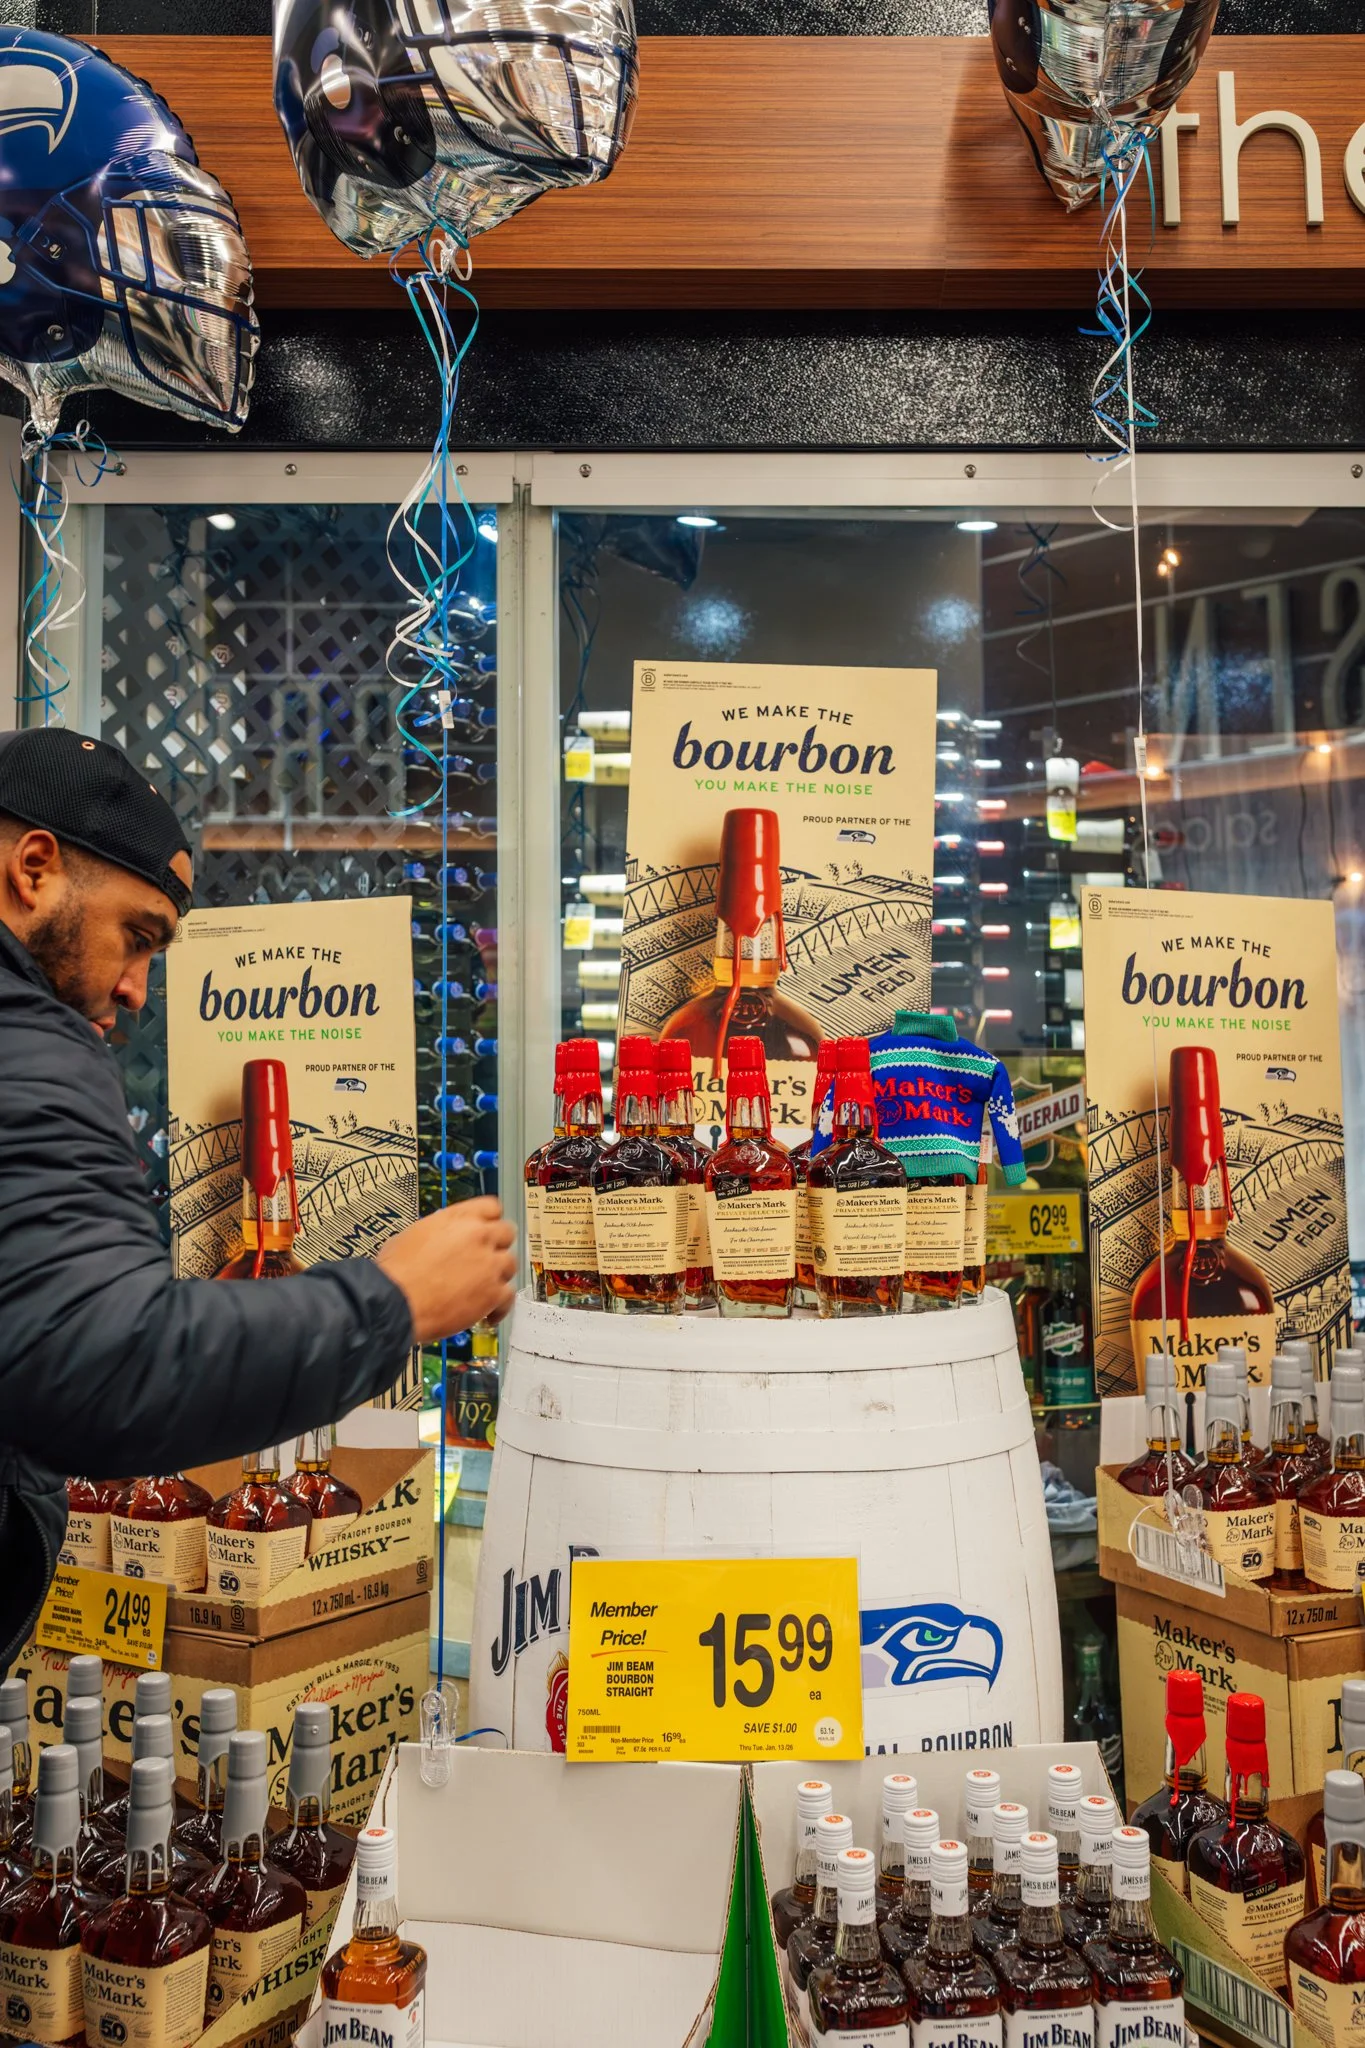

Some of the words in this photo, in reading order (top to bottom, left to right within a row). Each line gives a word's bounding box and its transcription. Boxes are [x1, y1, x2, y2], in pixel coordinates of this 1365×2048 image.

[722, 707, 748, 721] WE
[756, 705, 809, 718] MAKE
[817, 707, 853, 725] THE
[673, 721, 896, 775] bourbon
[694, 779, 726, 791] YOU
[733, 781, 779, 792] MAKE
[785, 782, 816, 794] THE
[823, 783, 873, 795] NOISE
[802, 815, 833, 824] PROUD
[835, 816, 877, 825] PARTNER
[879, 817, 891, 825] OF
[893, 818, 911, 826] THE
[235, 952, 257, 968] WE
[263, 946, 305, 962] MAKE
[311, 948, 342, 964] THE
[1161, 938, 1184, 952] WE
[1190, 936, 1235, 949] MAKE
[1241, 939, 1272, 958] THE
[807, 948, 912, 1004] LUMEN
[1122, 952, 1308, 1010] bourbon
[200, 965, 380, 1021] bourbon
[860, 970, 916, 1003] FIELD
[1142, 1015, 1170, 1028] YOU
[1176, 1017, 1214, 1029] MAKE
[1220, 1018, 1246, 1030] THE
[1251, 1019, 1292, 1031] NOISE
[217, 1031, 243, 1042] YOU
[248, 1030, 284, 1041] MAKE
[290, 1029, 316, 1040] THE
[321, 1028, 362, 1040] NOISE
[305, 1064, 331, 1072] PROUD
[332, 1063, 366, 1072] PARTNER
[368, 1063, 378, 1071] OF
[380, 1063, 395, 1071] THE
[1236, 1053, 1261, 1061] PROUD
[1263, 1054, 1296, 1062] PARTNER
[692, 1071, 807, 1097] Mar's
[873, 1077, 973, 1104] Maker's
[903, 1099, 972, 1127] Mark
[1252, 1189, 1332, 1252] LUMEN
[1294, 1212, 1337, 1248] FIELD
[1149, 1331, 1260, 1358] Maker's
[113, 1521, 160, 1538] Maker's
[374, 1516, 412, 1533] BOURBON
[1226, 1512, 1274, 1527] Maker's
[208, 1531, 255, 1549] Maker's
[1241, 1525, 1274, 1541] Mark
[123, 1538, 160, 1553] Mark
[308, 1535, 392, 1572] WHISKY
[218, 1548, 255, 1564] Mark
[1242, 1552, 1262, 1568] 50
[125, 1564, 144, 1578] 50
[55, 1586, 75, 1599] Price!
[219, 1575, 239, 1592] 50
[313, 1599, 322, 1616] 12
[330, 1592, 344, 1610] 750
[363, 1582, 379, 1600] 16.9
[380, 1581, 389, 1597] kg
[190, 1607, 209, 1625] 16.9
[211, 1612, 222, 1629] kg
[590, 1601, 658, 1618] Member
[1287, 1610, 1297, 1625] 12
[1307, 1607, 1324, 1624] 750
[491, 1567, 562, 1676] JIM
[142, 1628, 151, 1637] ea
[600, 1629, 647, 1646] Price!
[1153, 1614, 1236, 1664] Maker's
[126, 1638, 139, 1648] SAVE
[606, 1661, 623, 1671] JIM
[626, 1661, 654, 1671] BEAM
[1175, 1649, 1237, 1693] Mark
[286, 1693, 304, 1712] EST.
[304, 1680, 315, 1694] BY
[316, 1669, 334, 1684] BILL
[336, 1665, 341, 1674] &
[374, 1659, 384, 1667] KY
[384, 1661, 400, 1674] 1953
[606, 1674, 654, 1684] BOURBON
[606, 1687, 654, 1697] STRAIGHT
[809, 1690, 822, 1701] ea
[743, 1723, 770, 1733] SAVE
[772, 1723, 797, 1733] $1.00
[370, 1874, 388, 1885] BEAM
[1255, 1900, 1286, 1912] Maker's
[1287, 1894, 1304, 1905] Mark
[1244, 1911, 1274, 1921] PRIVATE
[5, 1968, 50, 1989] Mark
[84, 1961, 146, 1989] Maker's
[98, 1985, 147, 2008] Mark
[7, 2001, 31, 2021] 50
[101, 2017, 127, 2041] 50
[322, 2020, 347, 2048] JIM
[349, 2017, 394, 2048] BEAM
[1051, 2023, 1091, 2048] BEAM
[1109, 2022, 1140, 2048] JIM
[1143, 2015, 1182, 2045] BEAM
